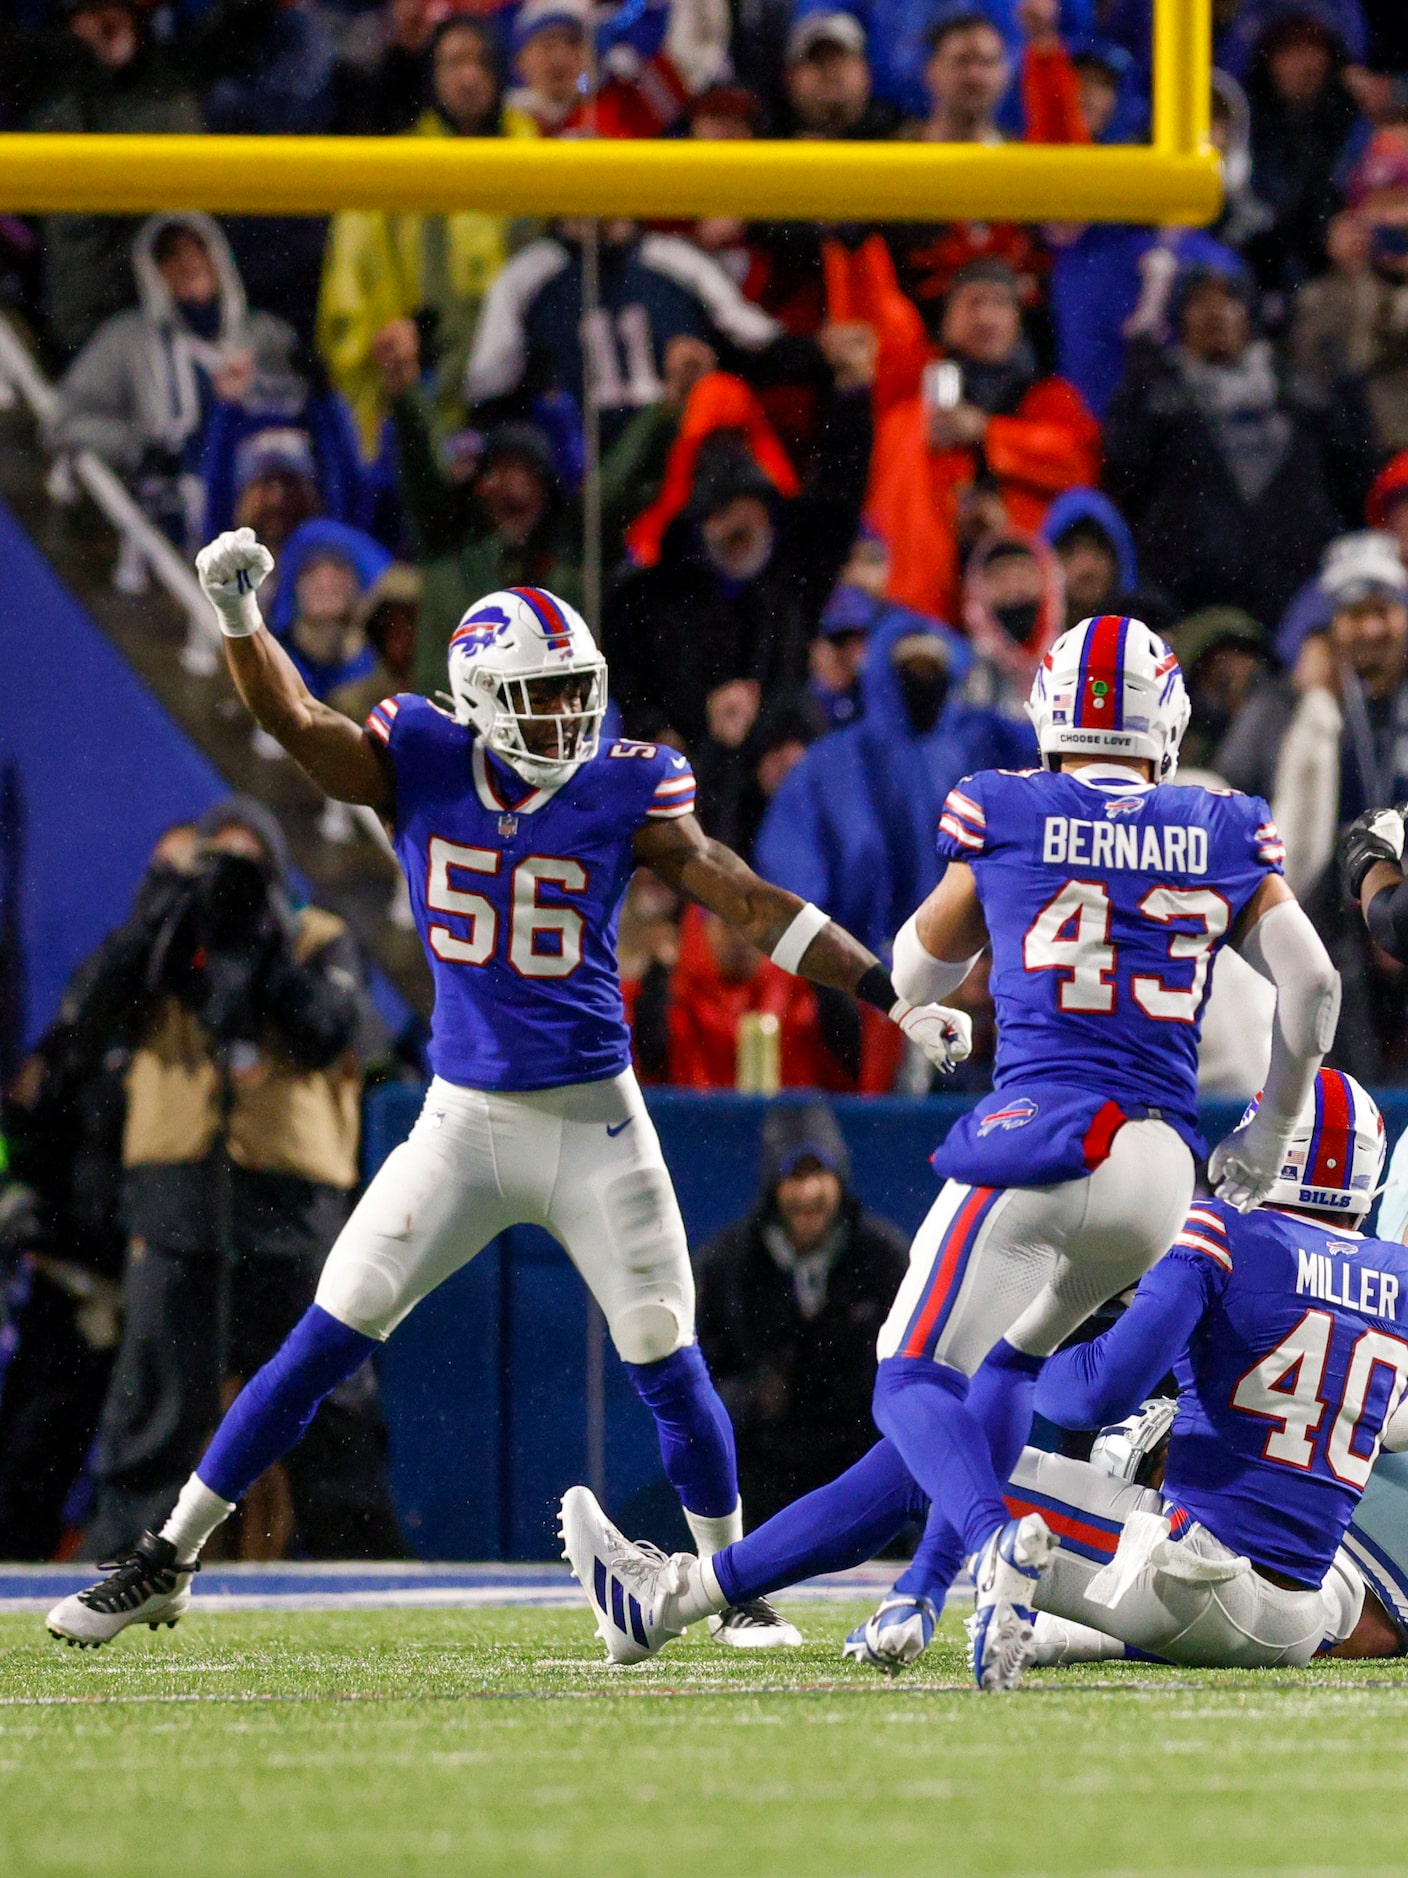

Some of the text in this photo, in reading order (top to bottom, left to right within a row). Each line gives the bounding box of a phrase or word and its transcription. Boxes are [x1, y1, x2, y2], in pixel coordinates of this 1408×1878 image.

[1060, 734, 1132, 746] CHOOSE LOVE
[1042, 816, 1208, 875] BERNARD
[426, 834, 590, 978] 56
[1022, 878, 1232, 1025] 43
[1299, 1189, 1351, 1208] BILLS
[1295, 1248, 1399, 1321] MILLER
